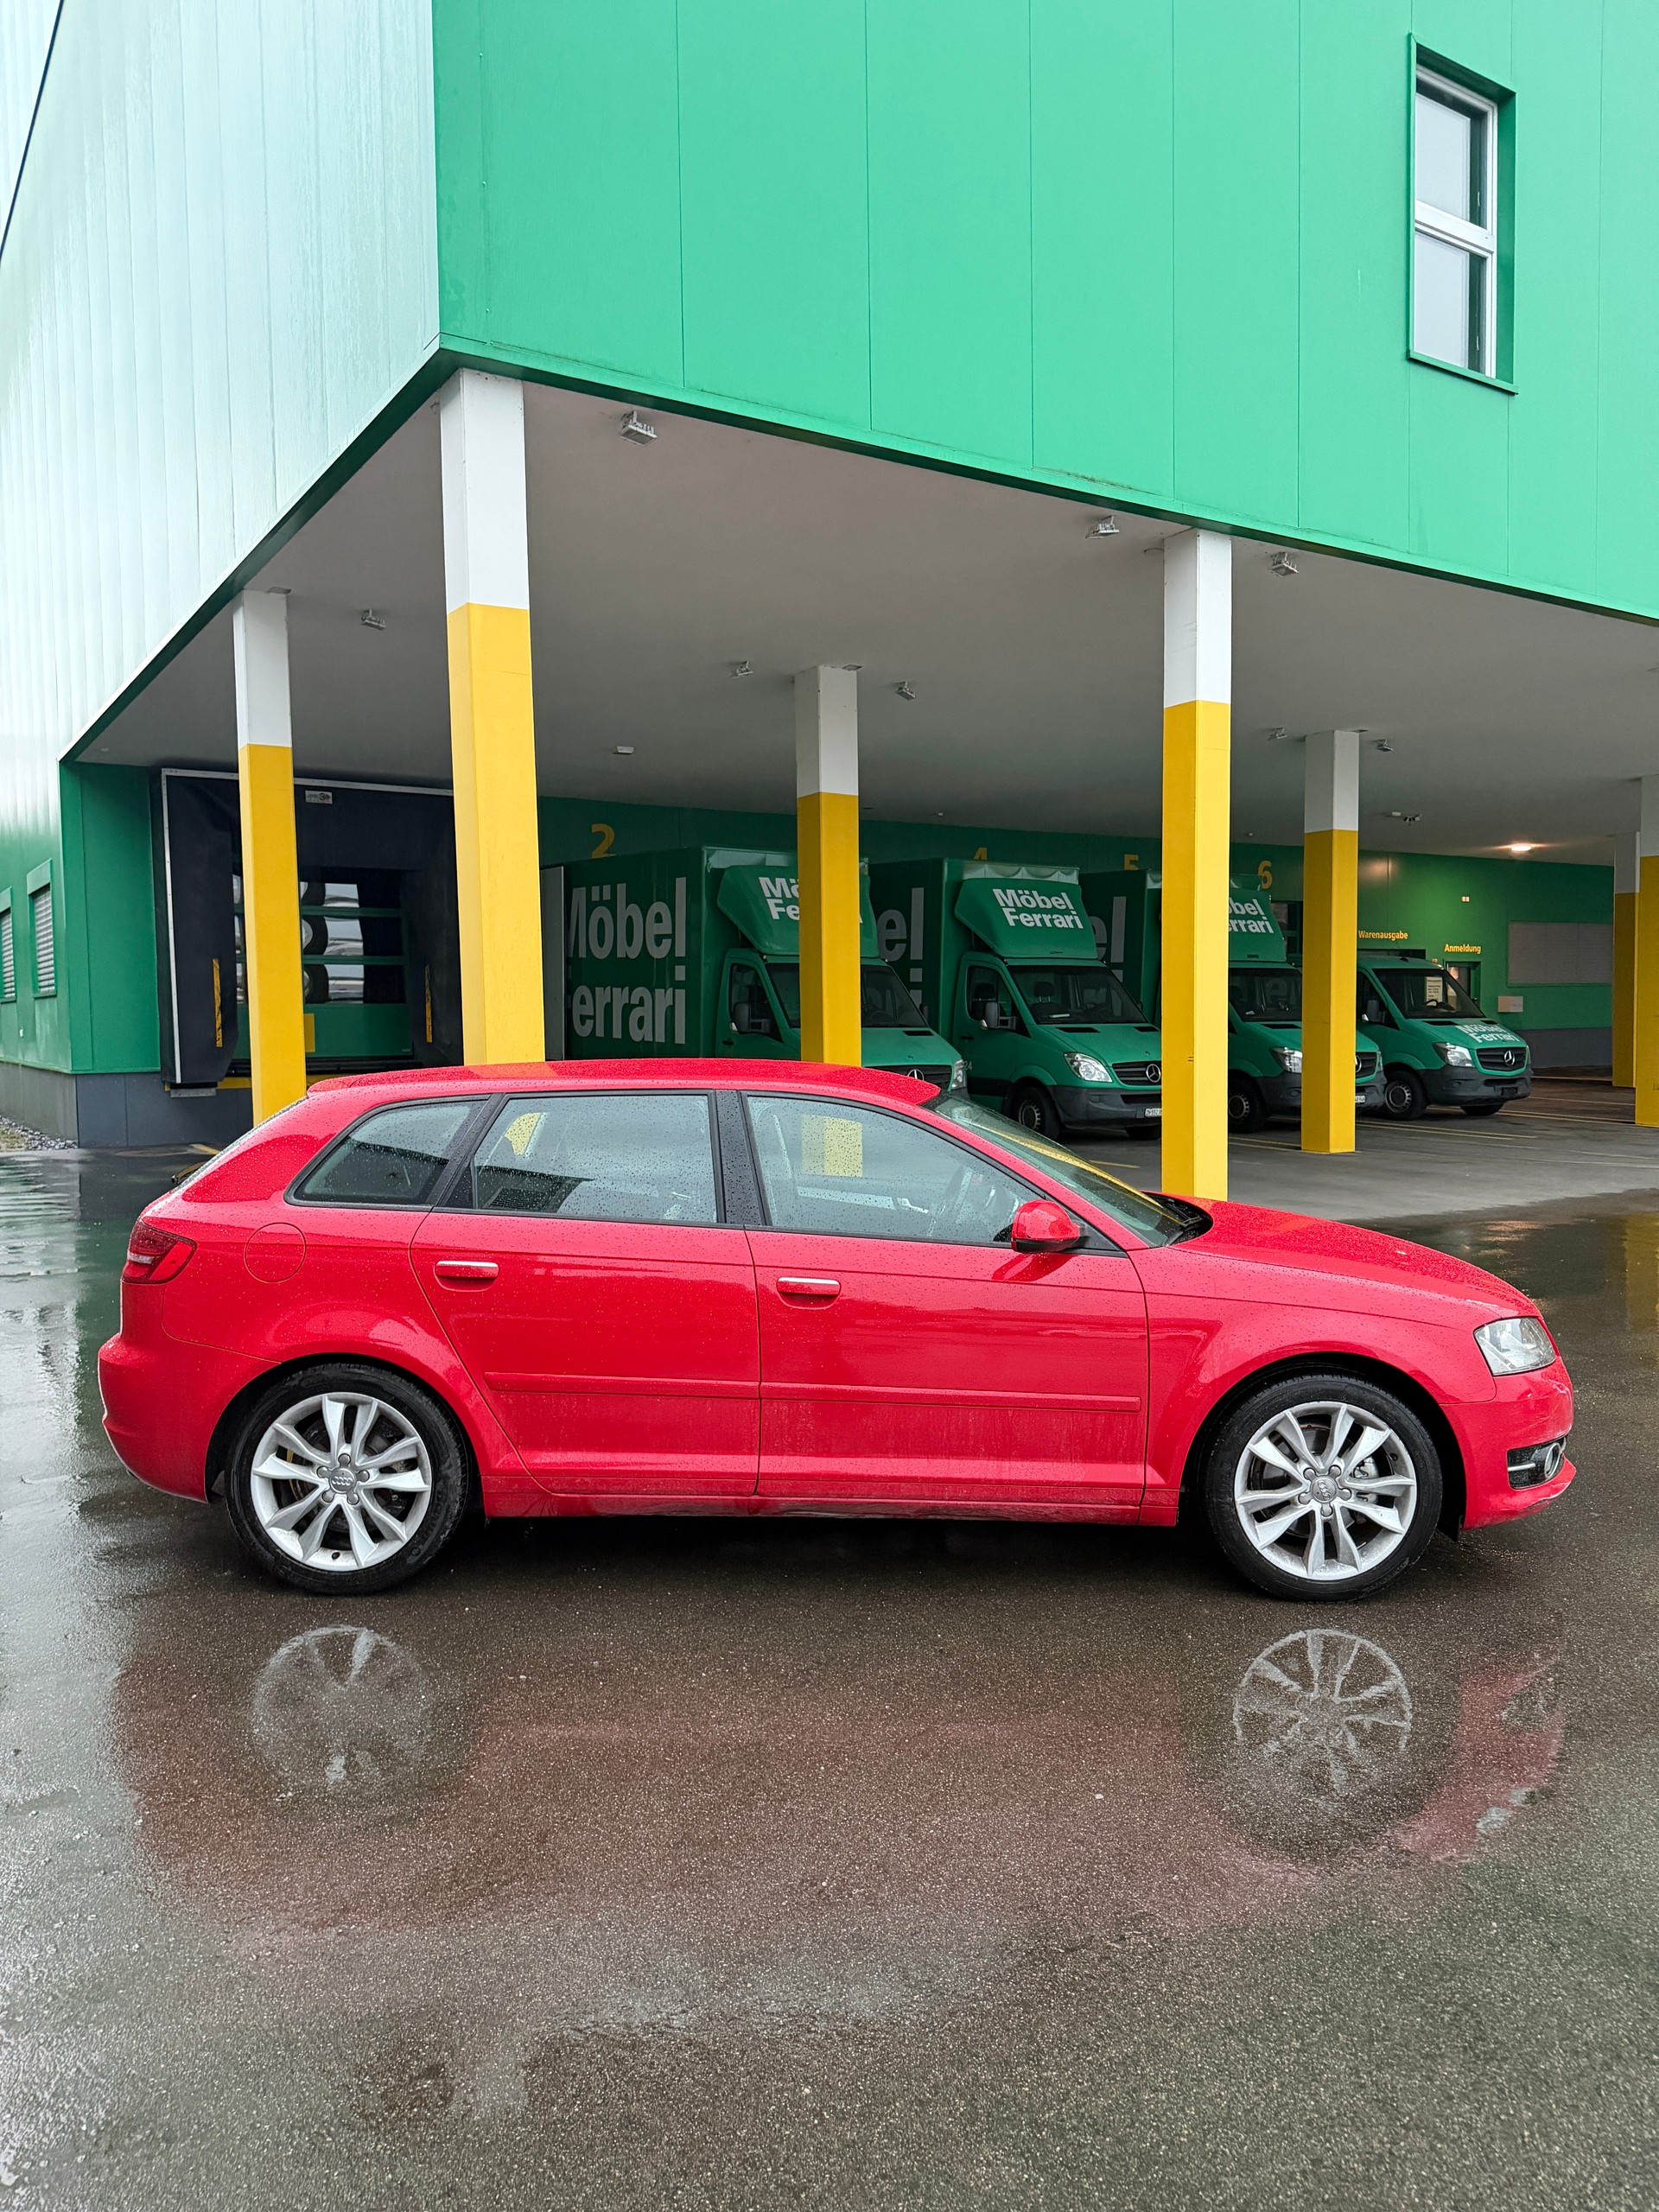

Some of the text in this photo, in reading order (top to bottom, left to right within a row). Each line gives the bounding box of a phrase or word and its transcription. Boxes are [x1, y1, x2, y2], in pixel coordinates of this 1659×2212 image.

[591, 823, 616, 859] 2
[1258, 861, 1272, 889] 6
[993, 888, 1074, 910] Möbel
[1229, 897, 1265, 916] bel
[1002, 907, 1084, 929] Ferrari
[1229, 916, 1274, 934] rrari
[1358, 931, 1408, 941] Warenausgabe
[1445, 944, 1481, 954] Anmeldung
[568, 965, 686, 1045] errari
[1469, 1033, 1520, 1043] Ferrari
